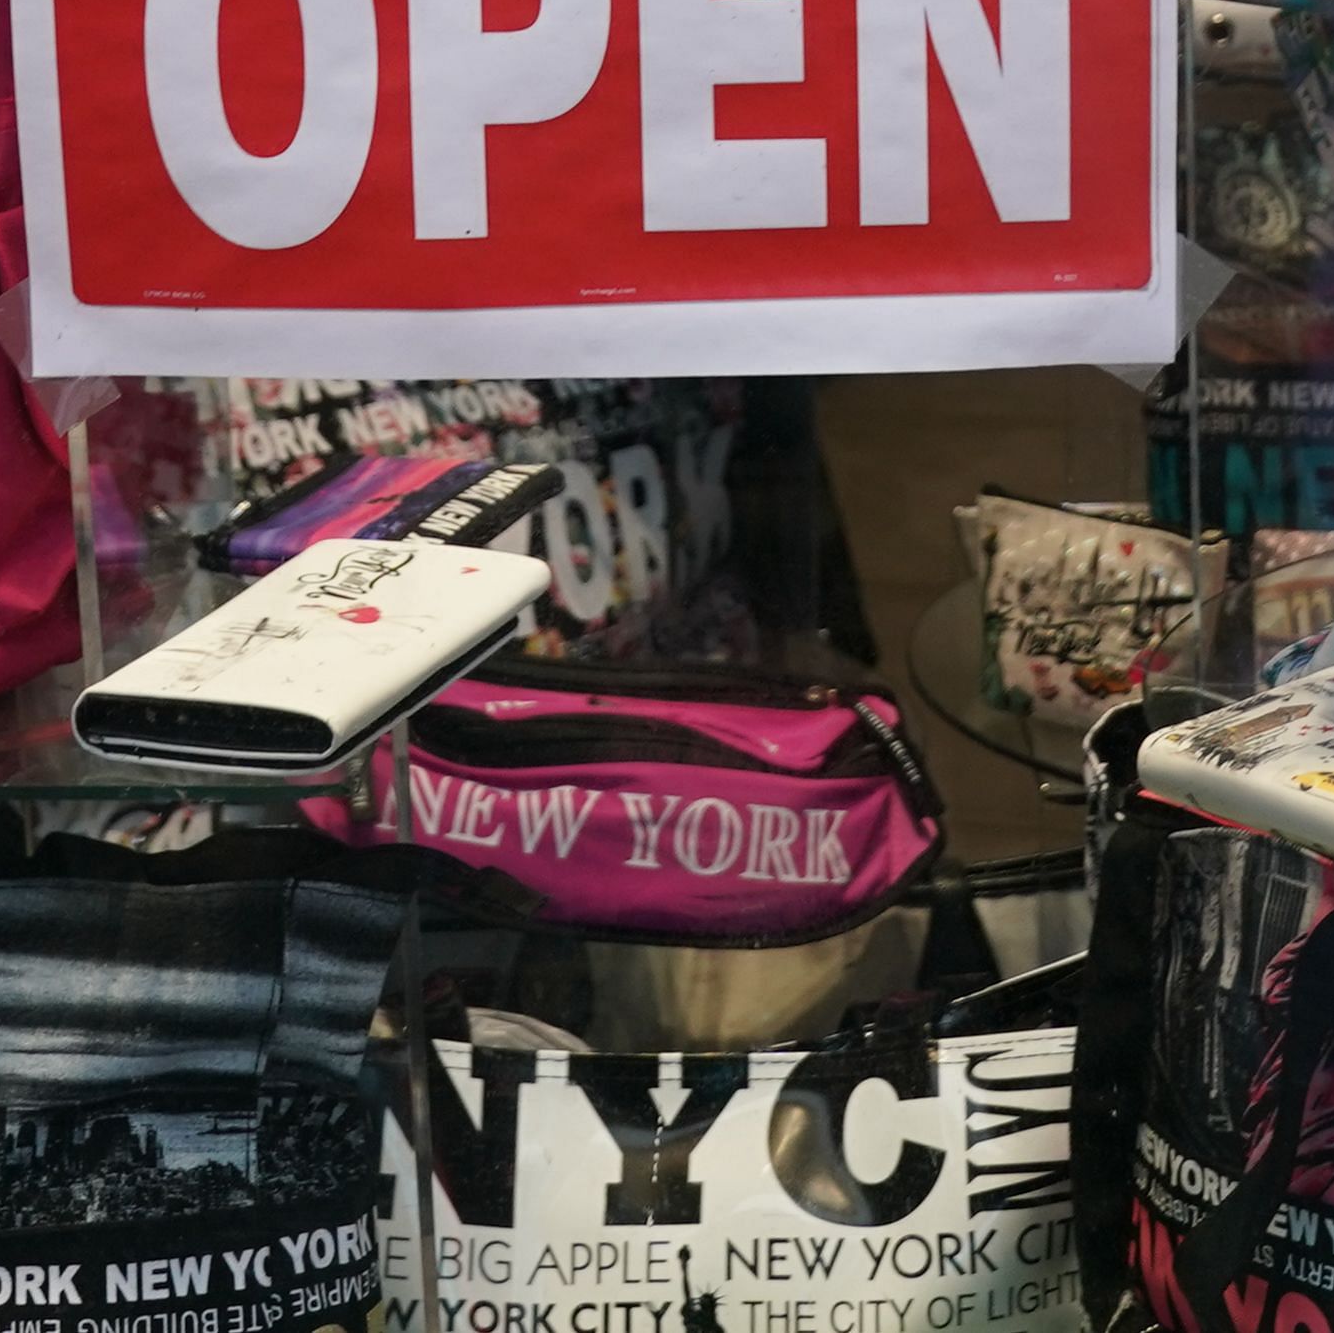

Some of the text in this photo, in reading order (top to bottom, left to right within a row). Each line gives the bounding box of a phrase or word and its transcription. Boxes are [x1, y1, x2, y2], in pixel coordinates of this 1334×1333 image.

[418, 468, 524, 536] NEW YORK
[376, 763, 853, 885] NEW YORK
[371, 1045, 947, 1229] NYC
[105, 1254, 213, 1304] NEW
[438, 1235, 512, 1286] BIG
[527, 1239, 671, 1286] APPLE
[725, 1237, 845, 1281] NEW
[862, 1229, 999, 1281] YORK
[742, 1300, 817, 1333] THE
[829, 1298, 915, 1333] CITY
[926, 1292, 977, 1330] OF
